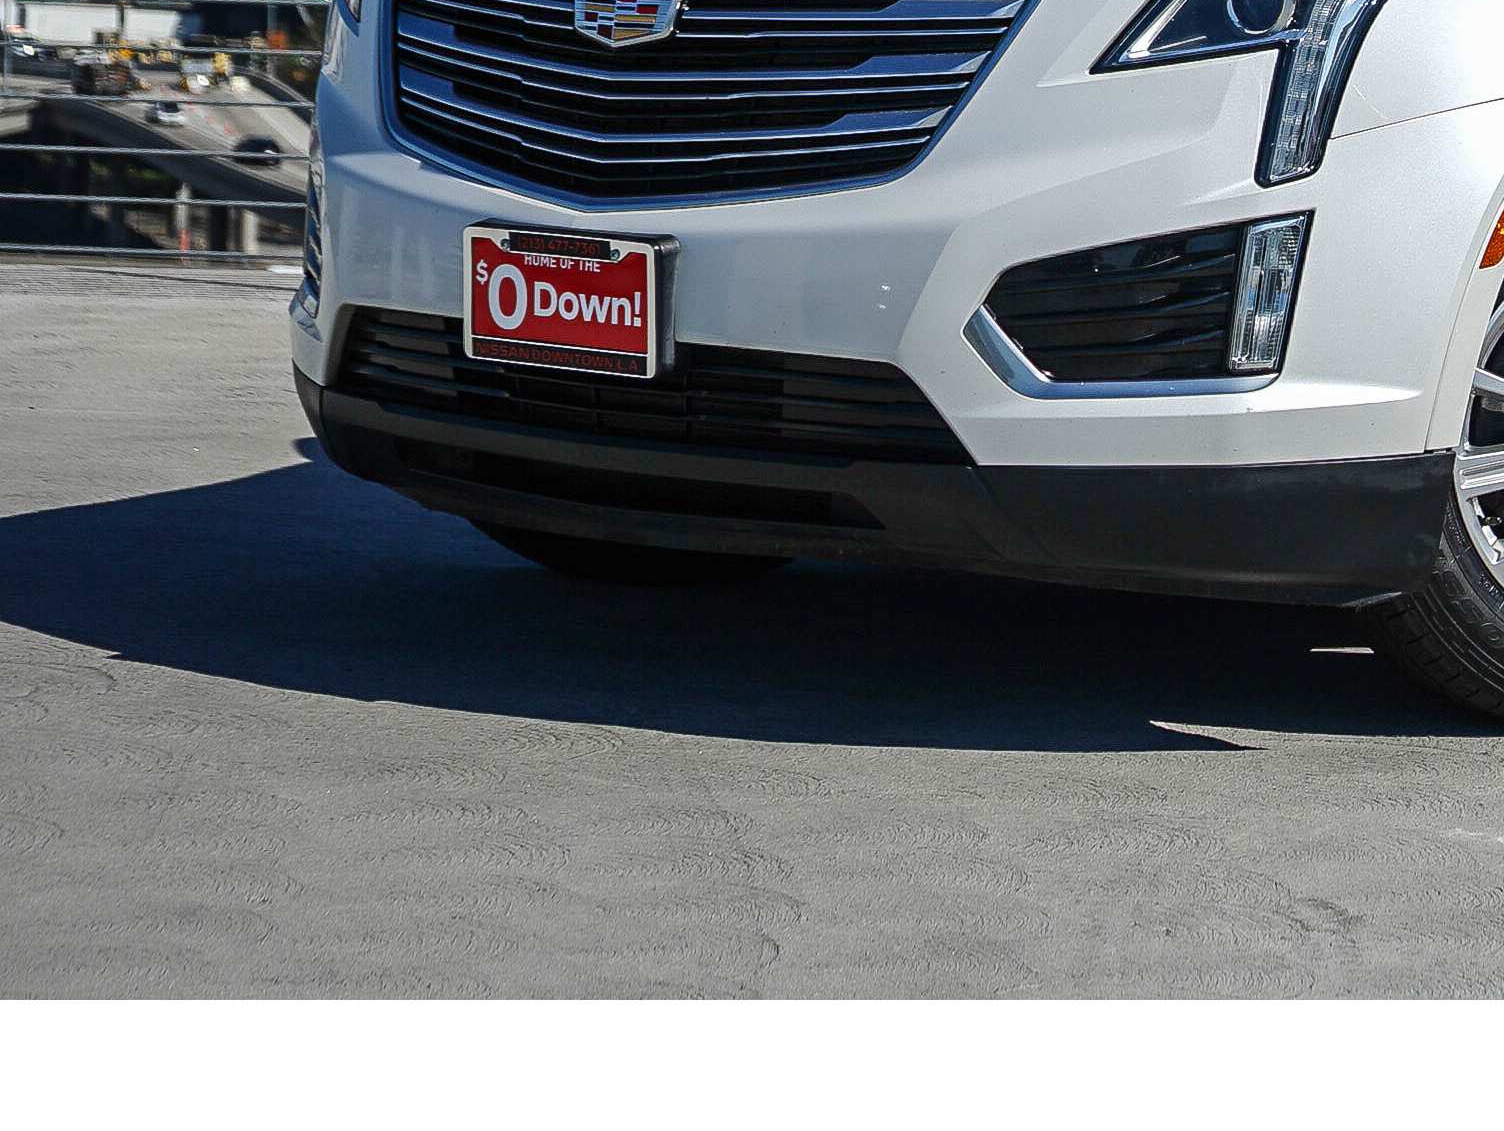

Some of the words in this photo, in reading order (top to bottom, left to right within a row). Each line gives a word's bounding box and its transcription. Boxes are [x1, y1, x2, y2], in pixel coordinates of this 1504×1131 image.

[524, 255, 557, 269] HOME
[560, 259, 576, 269] OF
[580, 260, 601, 273] THE
[533, 281, 642, 328] Down!
